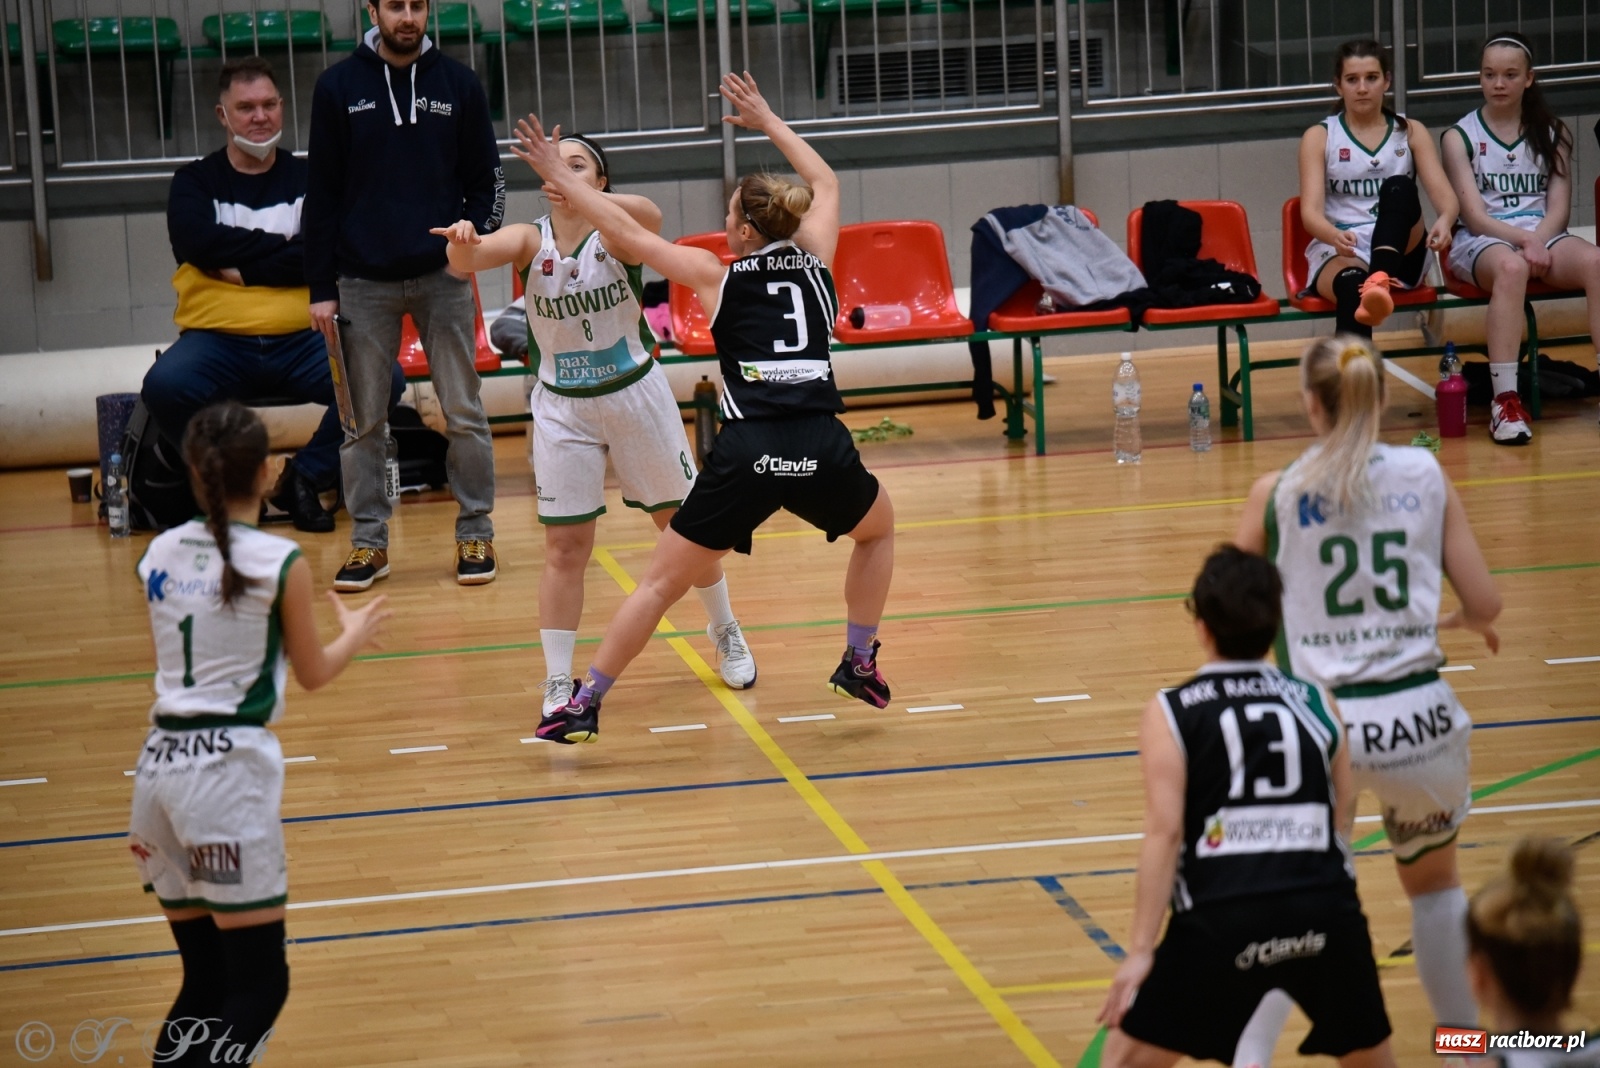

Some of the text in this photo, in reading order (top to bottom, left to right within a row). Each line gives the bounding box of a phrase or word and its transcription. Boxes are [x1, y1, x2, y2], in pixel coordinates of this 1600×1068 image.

[348, 101, 376, 114] SPALDING
[430, 100, 452, 112] SMS
[733, 258, 760, 272] RKK
[533, 279, 629, 321] KATOWICE
[766, 281, 809, 353] 3
[582, 318, 594, 342] 8
[558, 356, 590, 368] max
[680, 450, 693, 480] 8
[770, 457, 818, 472] Clavis
[1319, 529, 1410, 617] 25
[1361, 623, 1437, 641] KATOWIC
[178, 613, 196, 688] 1
[1219, 702, 1303, 799] 13
